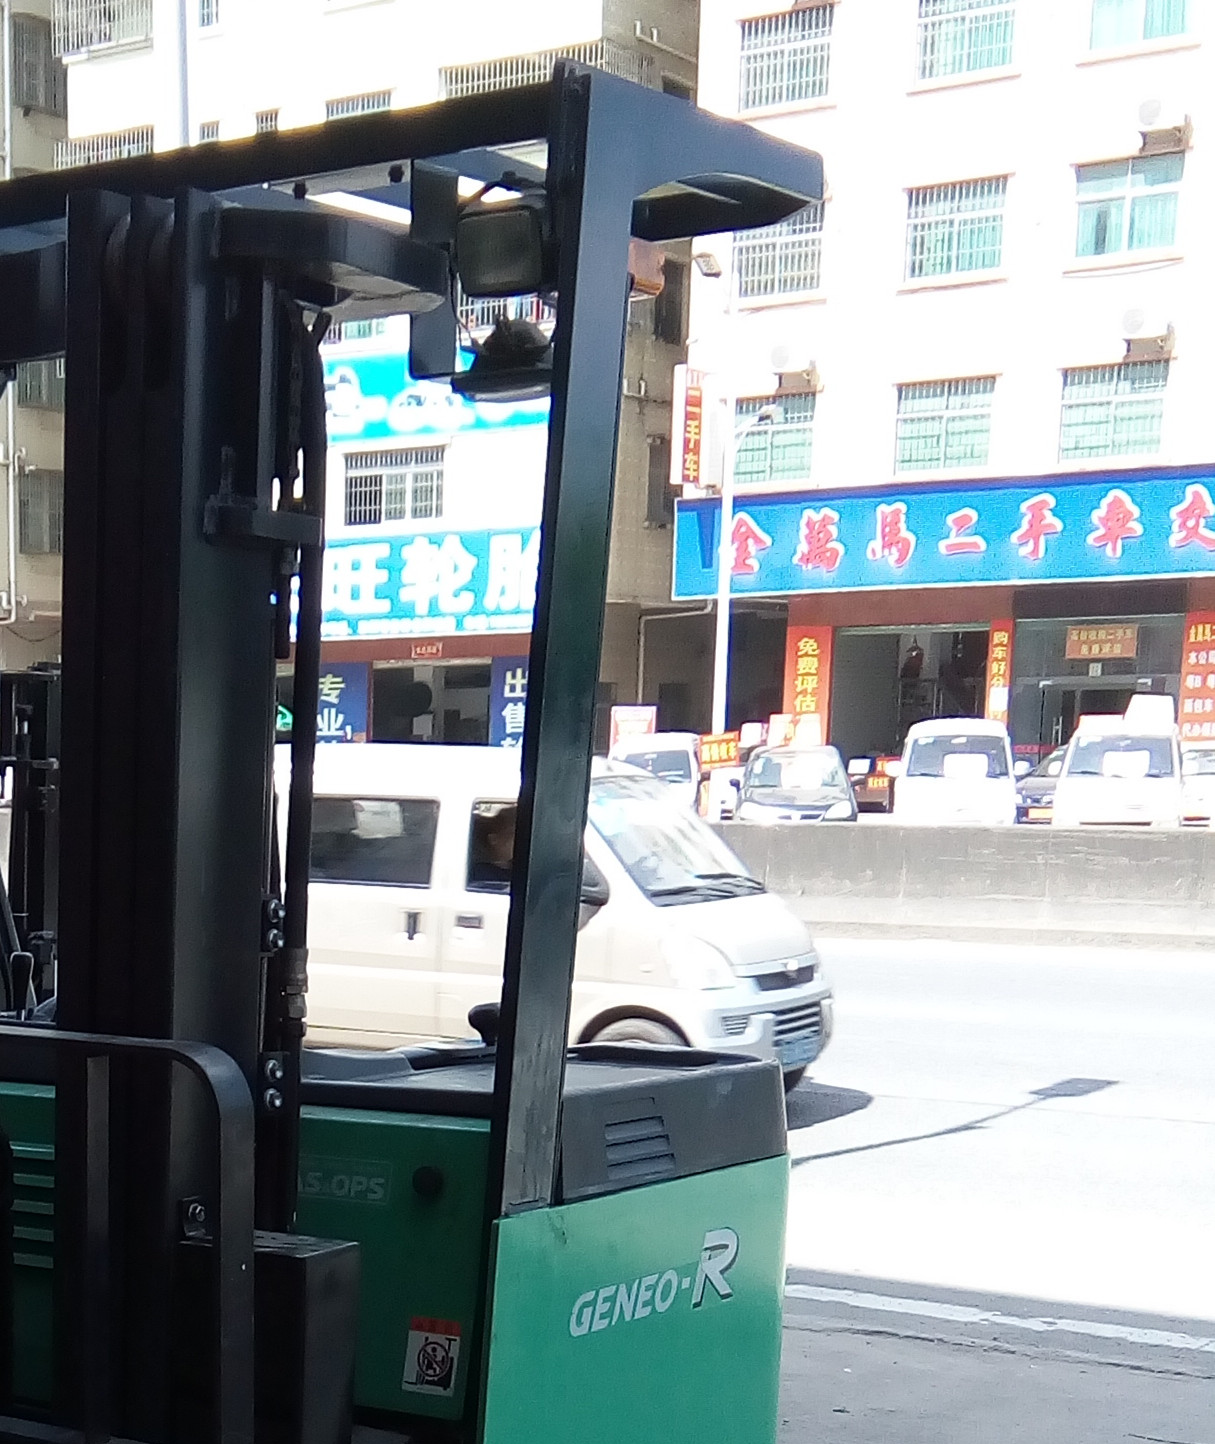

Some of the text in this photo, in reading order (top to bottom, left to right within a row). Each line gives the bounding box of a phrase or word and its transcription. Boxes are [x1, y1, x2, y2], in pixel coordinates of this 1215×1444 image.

[685, 387, 702, 482] 二手车
[501, 667, 529, 747] 出售
[794, 637, 821, 712] 免费评估
[569, 1226, 740, 1338] GENEO-R
